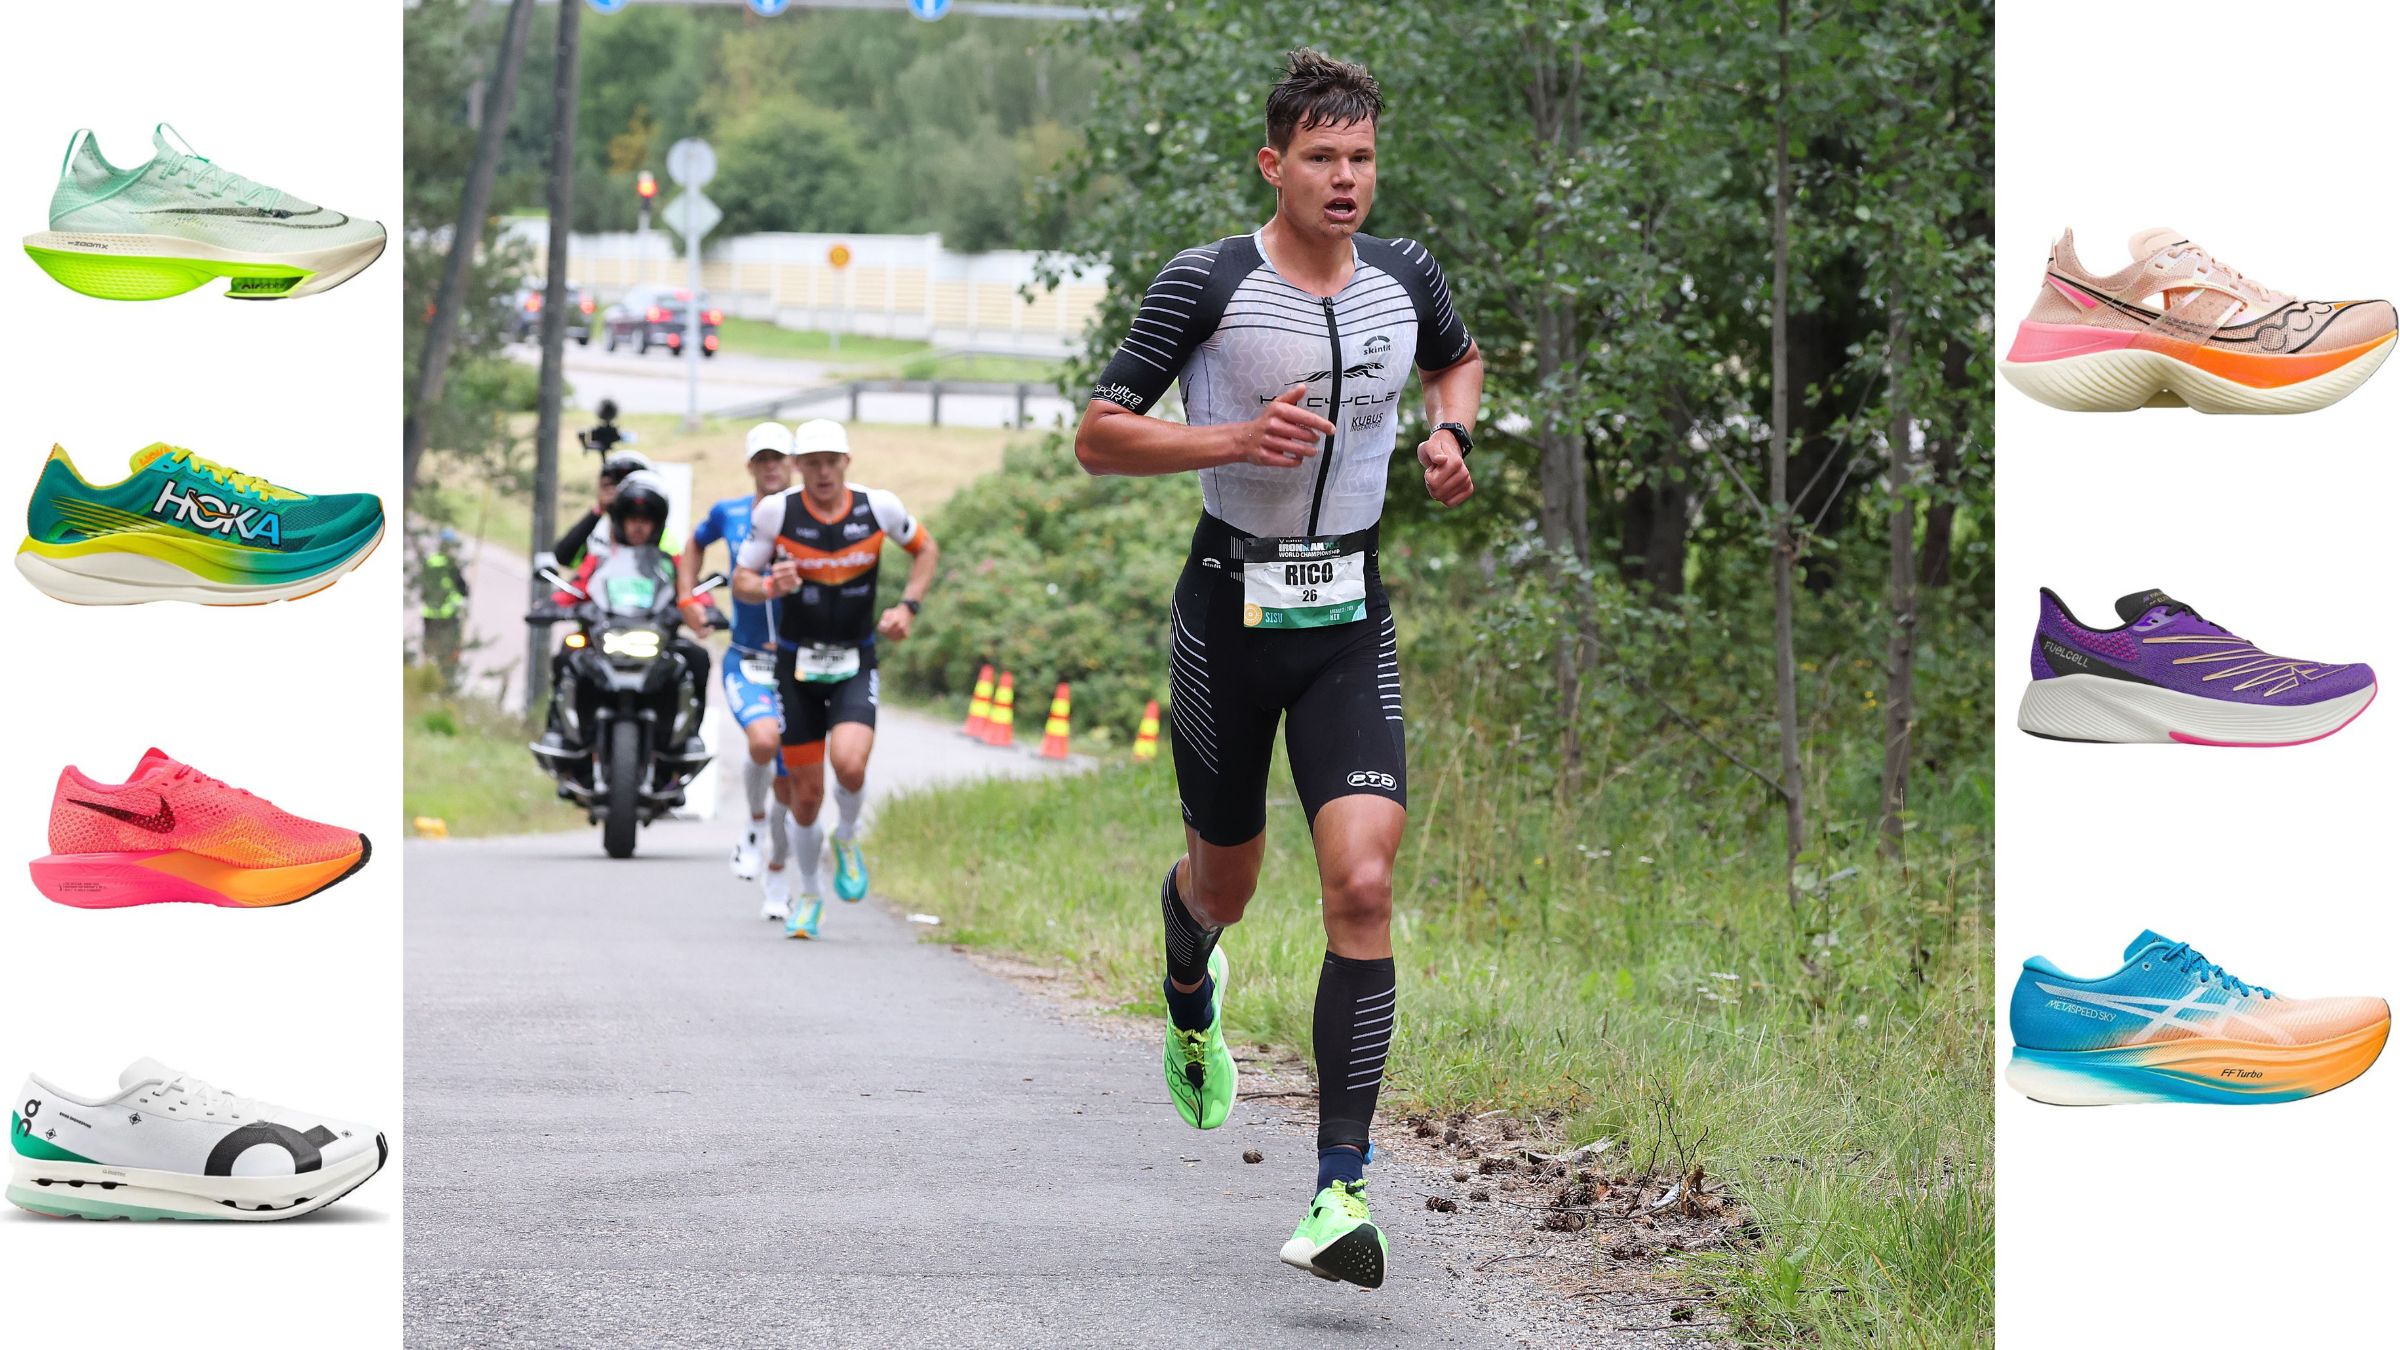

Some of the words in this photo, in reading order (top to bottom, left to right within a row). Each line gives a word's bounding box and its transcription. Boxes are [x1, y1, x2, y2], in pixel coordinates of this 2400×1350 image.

[1094, 384, 1136, 410] SPORTS
[1111, 382, 1143, 404] ultra
[1351, 412, 1383, 426] KUBUS
[152, 479, 281, 546] HOKA
[1300, 548, 1340, 558] CHAMPIONSHIP
[1285, 562, 1333, 585] RICO
[1302, 589, 1318, 602] 26
[1265, 611, 1284, 624] SISU
[2045, 1000, 2099, 1018] METASPEED
[2099, 1011, 2117, 1023] SKY
[2220, 1069, 2237, 1078] FF
[2236, 1069, 2264, 1079] Turbo
